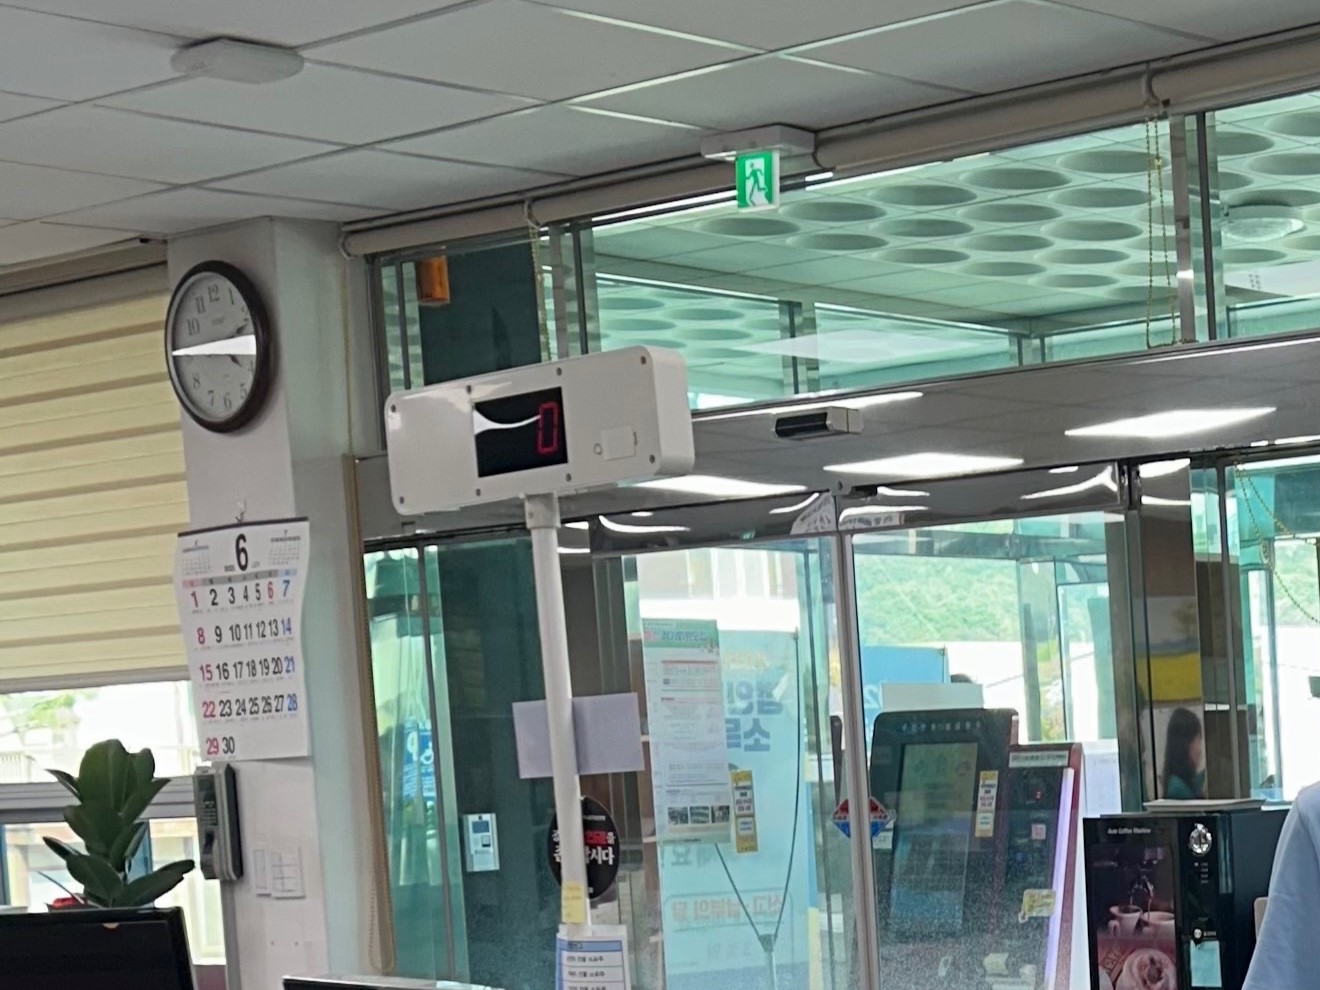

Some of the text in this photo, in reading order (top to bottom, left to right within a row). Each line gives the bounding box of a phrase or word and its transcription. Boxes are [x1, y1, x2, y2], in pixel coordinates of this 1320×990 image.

[534, 402, 558, 454] 0
[235, 533, 249, 571] 6
[190, 580, 290, 608] 1 2 3 4 5 6 7
[197, 617, 292, 645] 8 9 10 11 12 13 14
[199, 656, 295, 681] 15 16 17 18 19 20 21
[202, 693, 298, 718] 22 23 24 25 26 27 28
[206, 736, 235, 755] 29 30
